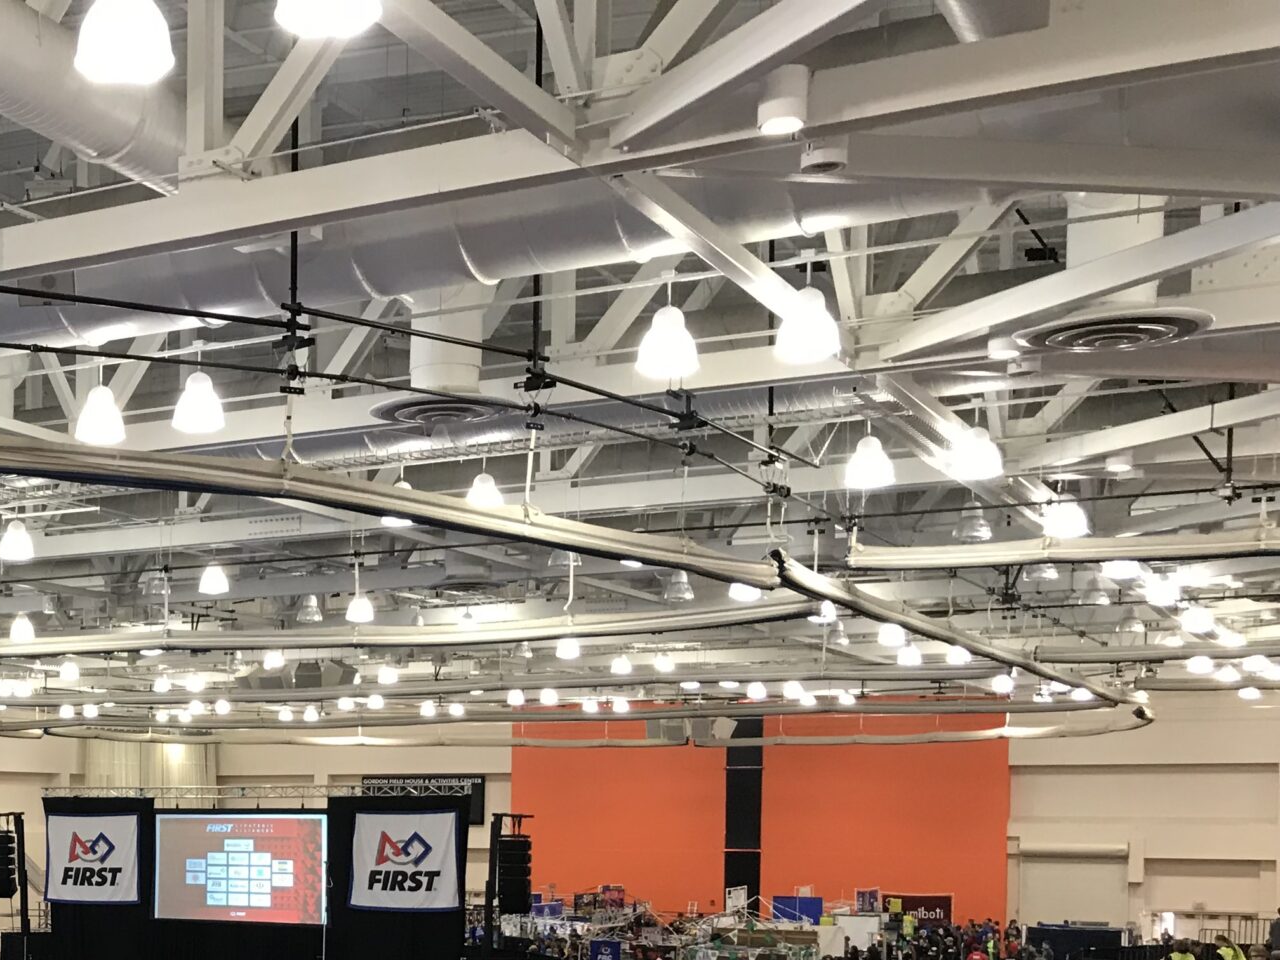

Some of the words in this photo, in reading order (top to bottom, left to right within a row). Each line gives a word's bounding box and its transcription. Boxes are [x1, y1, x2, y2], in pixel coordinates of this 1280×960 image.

[206, 823, 233, 832] FIRST
[61, 867, 122, 886] FIRST
[367, 870, 441, 892] FIRST
